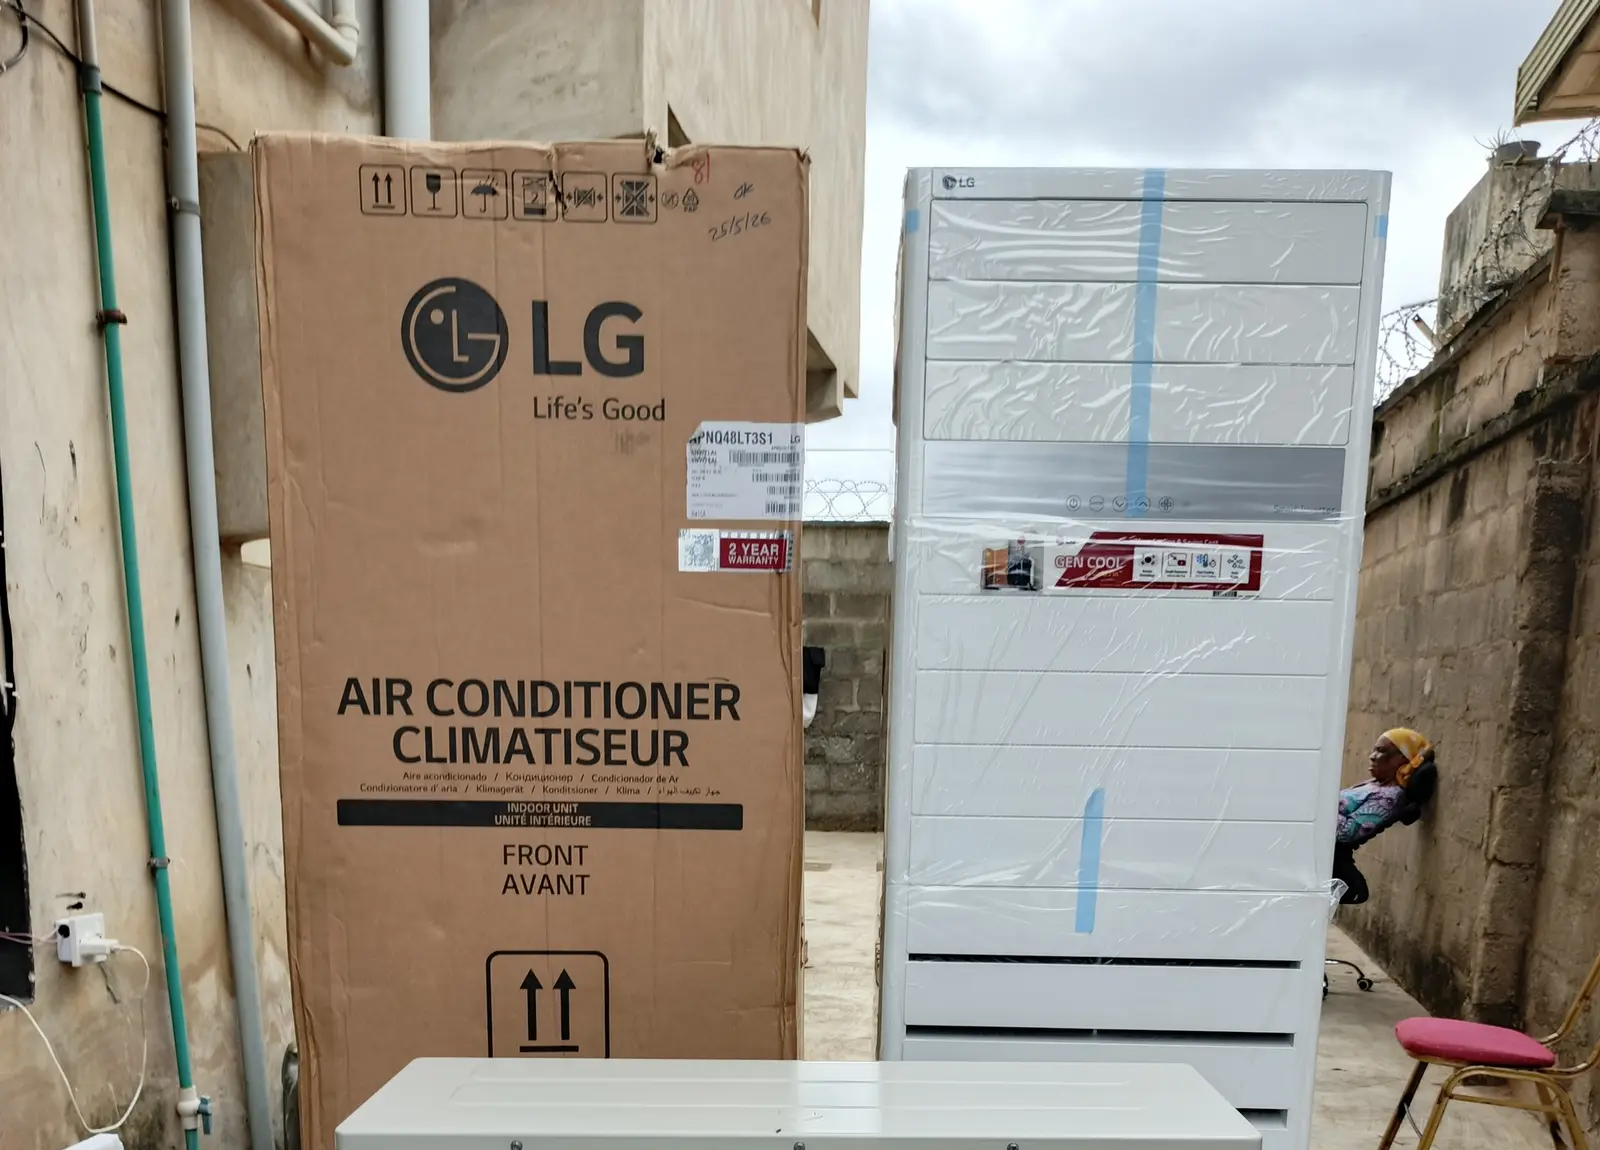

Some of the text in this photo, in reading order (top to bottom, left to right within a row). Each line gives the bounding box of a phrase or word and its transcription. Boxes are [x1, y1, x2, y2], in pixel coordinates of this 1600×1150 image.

[959, 176, 975, 188] LG
[532, 300, 645, 378] LG
[533, 396, 666, 421] Life's Good
[790, 434, 800, 445] LG
[729, 543, 779, 556] 2 YEAR
[728, 555, 779, 565] WARRANTY
[1055, 555, 1122, 569] GEN COOL
[337, 677, 741, 721] AIR CONDITIONER
[393, 726, 690, 767] CLIMATISEUR
[403, 772, 421, 781] Aire
[424, 772, 487, 782] acondicionado
[506, 773, 573, 784] Кондиционер
[591, 773, 653, 784] Condicionador
[656, 774, 667, 784] de
[669, 774, 679, 784] Ar
[360, 783, 428, 793] Condizionatore
[441, 784, 458, 793] aria
[476, 785, 524, 795] Klimagerät
[542, 785, 598, 795] Konditsioner
[616, 786, 641, 796] Klima
[507, 803, 578, 814] INDOOR UNIT
[494, 813, 592, 826] UNITÉ INTÉRIEURE
[503, 844, 589, 866] FRONT
[502, 873, 590, 895] AVANT
